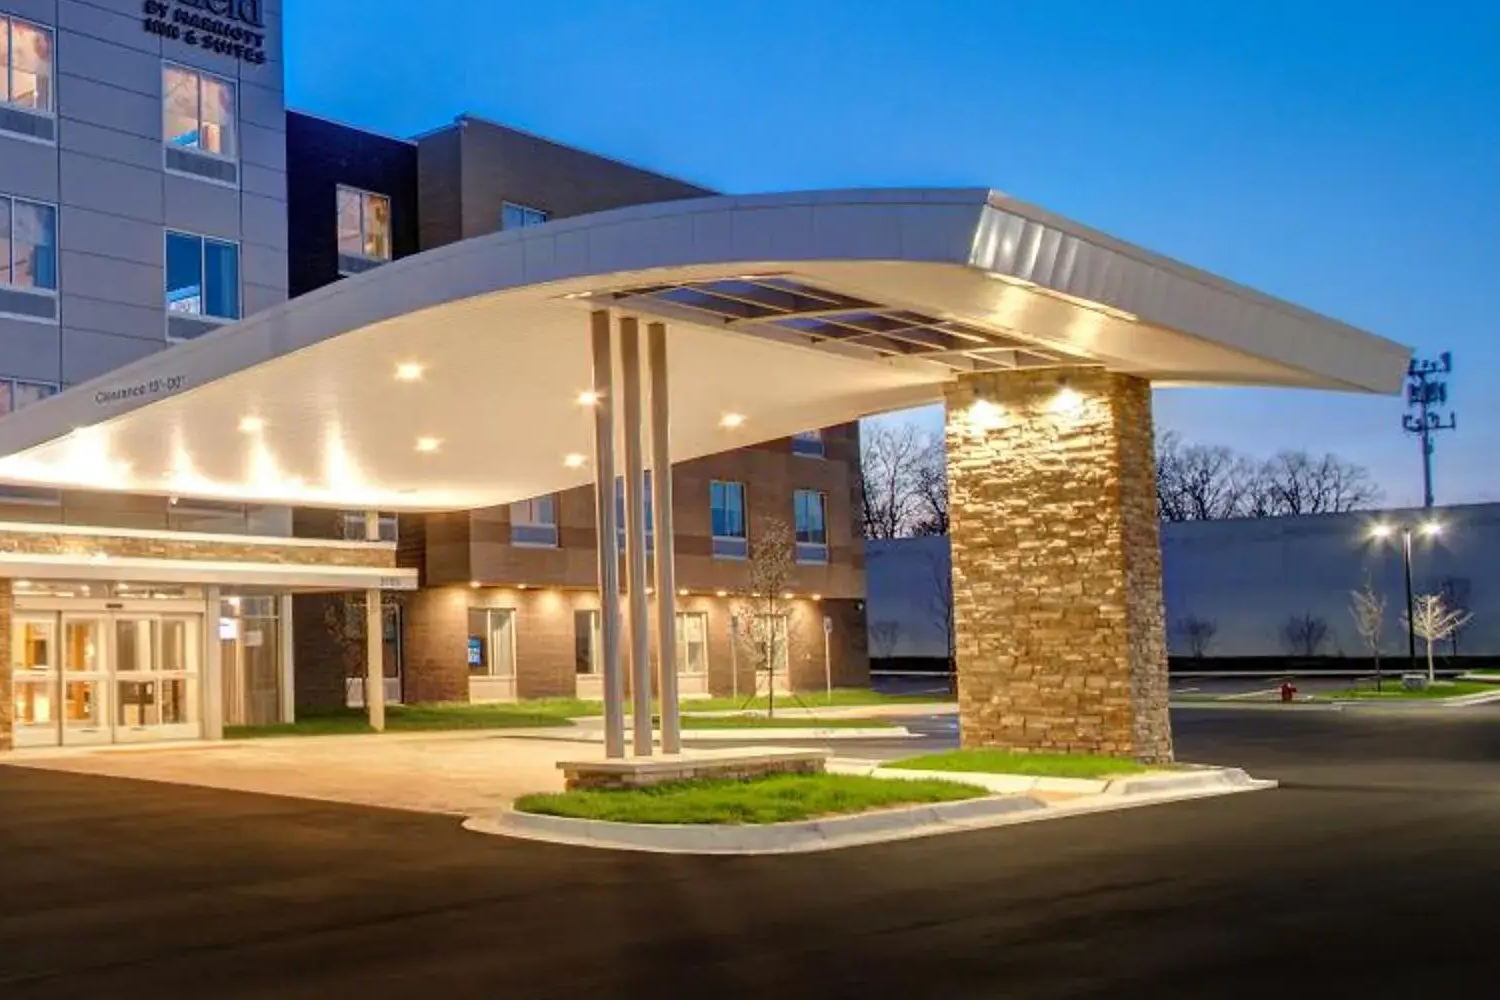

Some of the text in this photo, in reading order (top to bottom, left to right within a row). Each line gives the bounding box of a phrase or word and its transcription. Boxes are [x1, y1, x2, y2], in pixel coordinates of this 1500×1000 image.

[143, 0, 265, 47] BY MARRIOTT
[184, 30, 198, 45] &
[200, 35, 266, 64] SUITES
